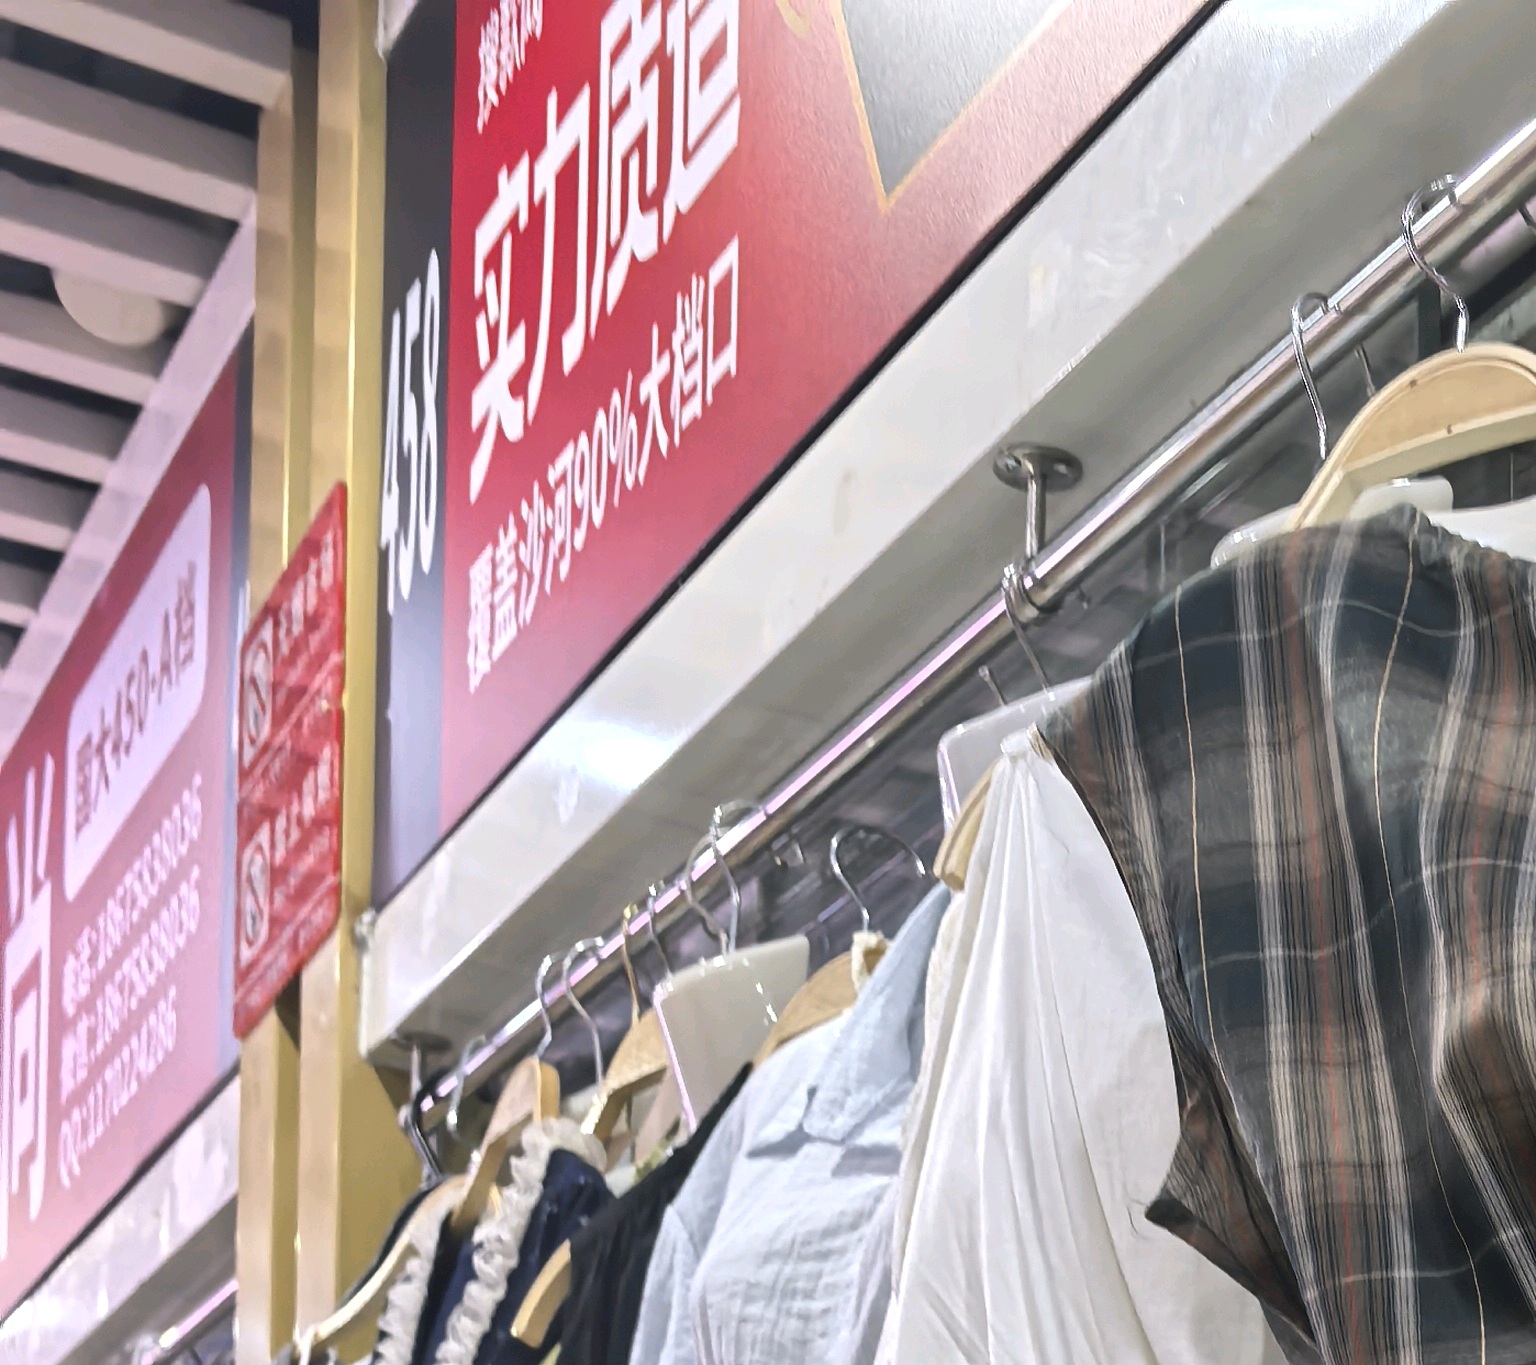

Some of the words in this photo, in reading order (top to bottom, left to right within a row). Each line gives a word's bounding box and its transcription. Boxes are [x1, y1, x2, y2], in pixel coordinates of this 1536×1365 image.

[380, 247, 440, 615] 458
[466, 233, 739, 694] 覆盖沙河90%大档口
